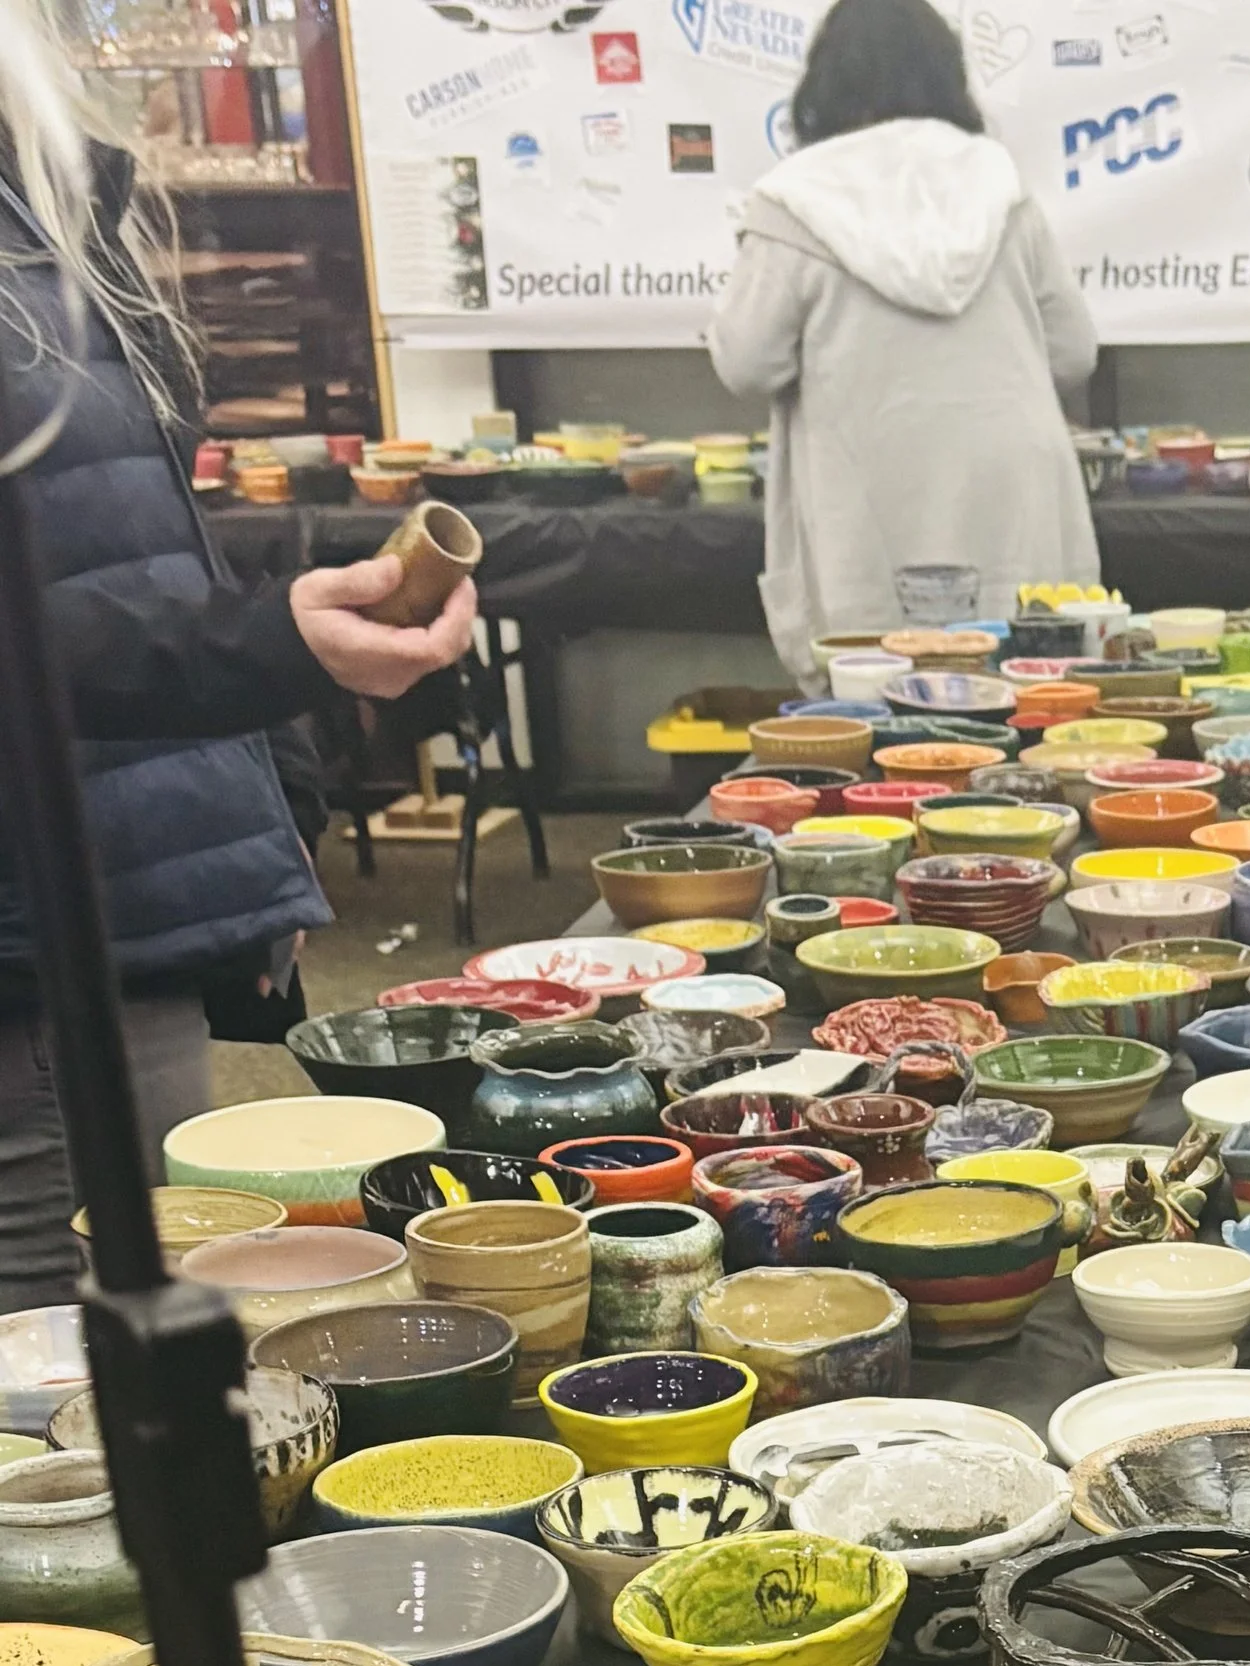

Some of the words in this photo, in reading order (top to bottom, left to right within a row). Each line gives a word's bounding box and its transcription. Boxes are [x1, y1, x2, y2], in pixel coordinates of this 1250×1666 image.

[403, 68, 483, 119] CARSON
[1063, 93, 1181, 188] PCC
[499, 262, 612, 303] Special
[1101, 253, 1221, 295] hosting
